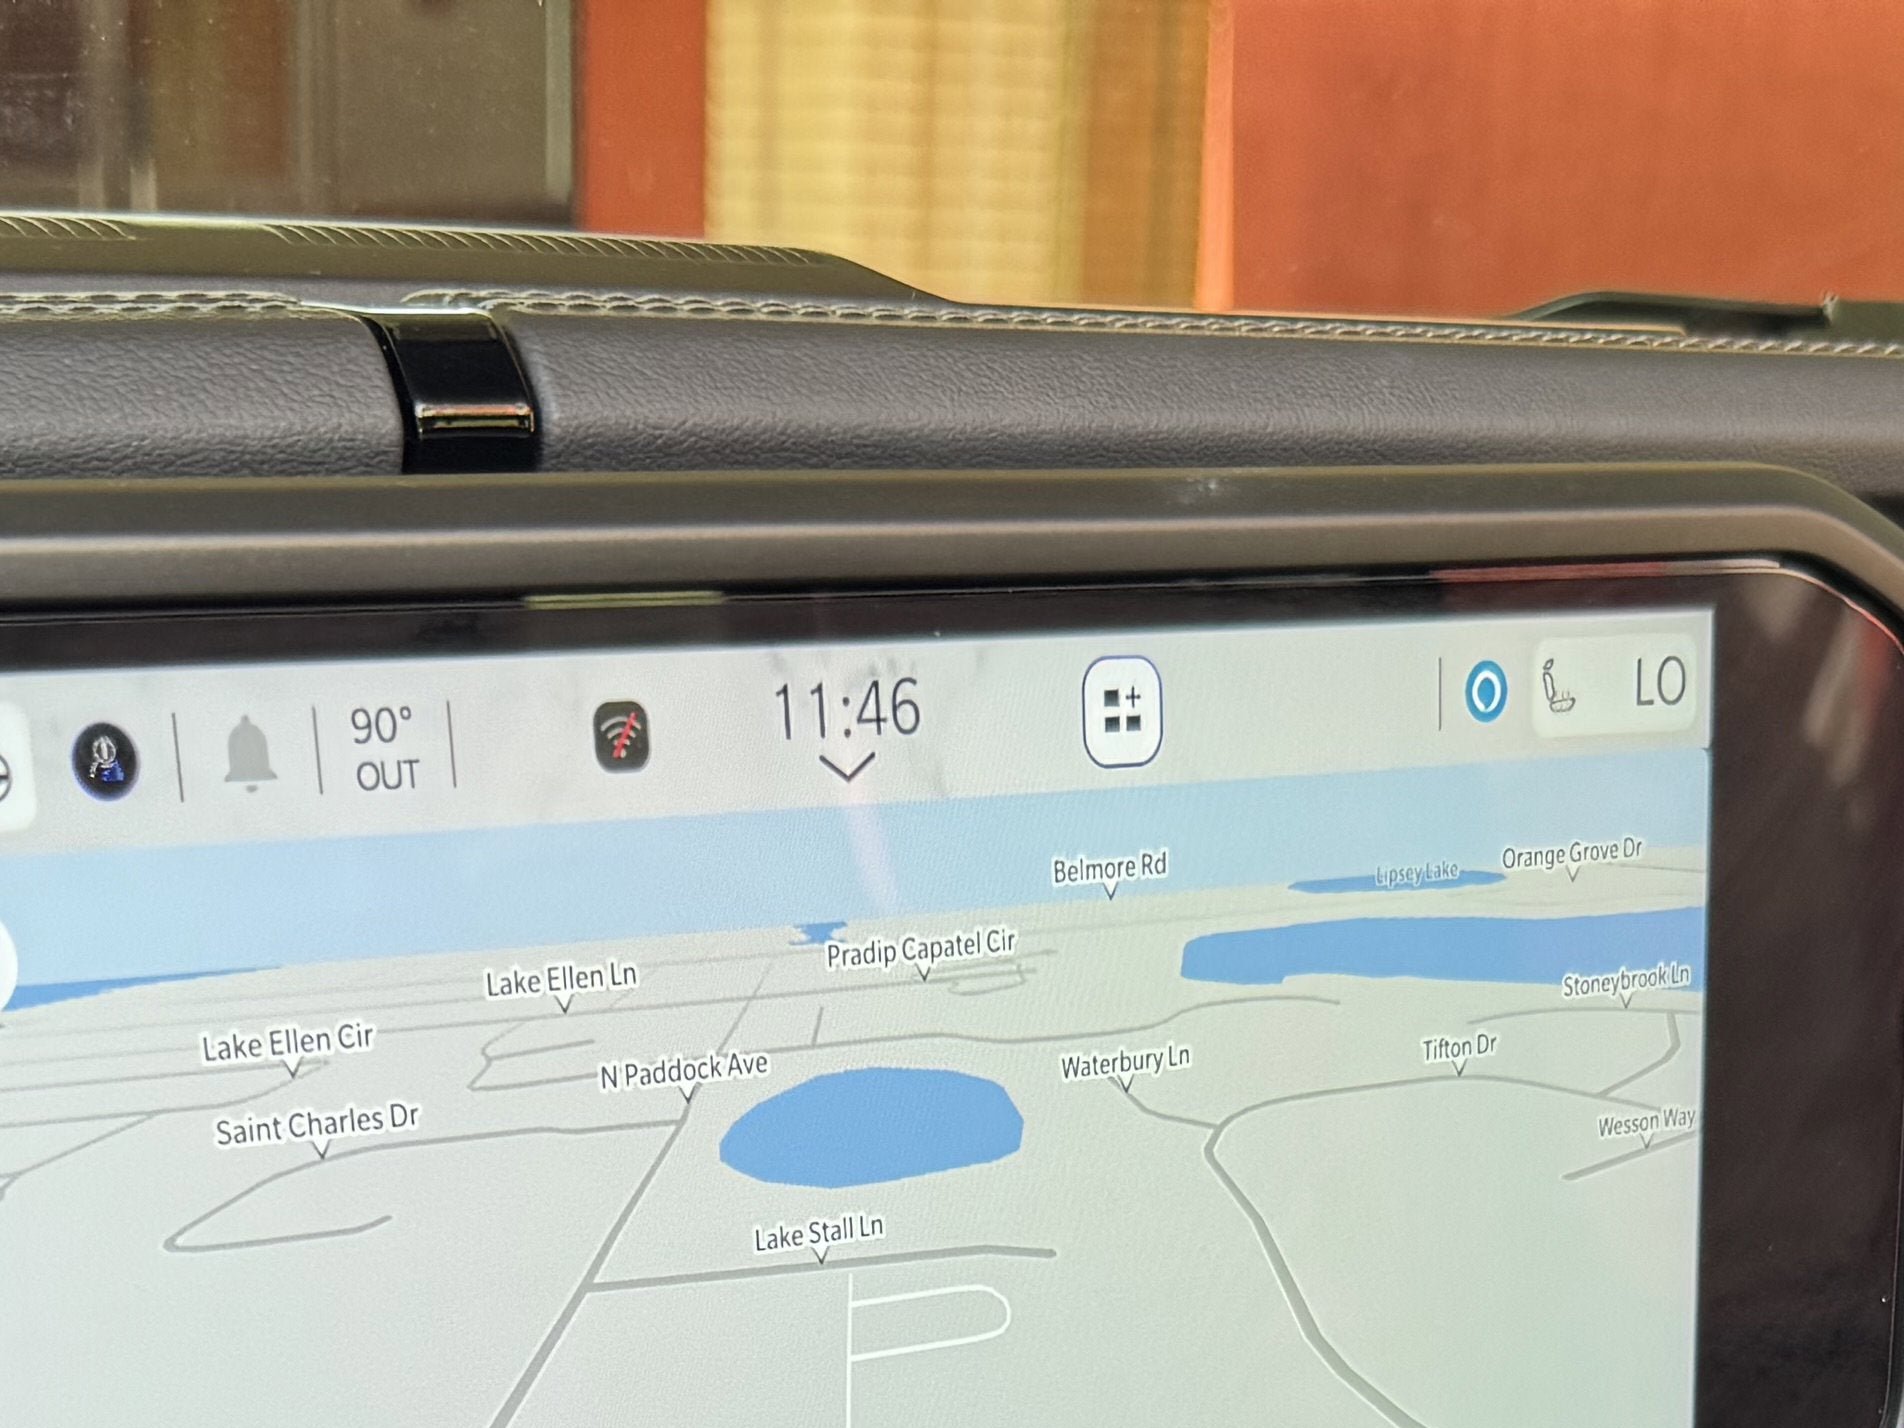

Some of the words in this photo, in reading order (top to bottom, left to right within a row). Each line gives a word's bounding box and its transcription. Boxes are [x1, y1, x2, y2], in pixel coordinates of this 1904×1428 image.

[1636, 655, 1687, 707] LO
[350, 705, 413, 744] 90°
[775, 676, 921, 740] 11:46
[355, 759, 421, 793] OUT
[1053, 856, 1137, 886] Belmore
[1141, 850, 1168, 878] Rd
[1376, 865, 1423, 887] Lipsey
[1426, 861, 1459, 881] Lake
[1502, 847, 1566, 873] Orange
[1569, 841, 1619, 863] Grove
[1623, 837, 1643, 860] Dr
[826, 940, 897, 970] Pradip
[901, 932, 984, 967] Capatel
[987, 929, 1016, 954] Cir
[485, 967, 542, 999] Lake
[547, 964, 604, 994] Ellen
[610, 961, 637, 989] Ln
[1563, 968, 1669, 999] Stoneybrook
[1671, 964, 1691, 985] Ln
[201, 1031, 263, 1064] Lake
[268, 1027, 332, 1057] Ellen
[338, 1023, 375, 1051] Cir
[1061, 1049, 1165, 1081] Waterbury
[1167, 1044, 1190, 1069] Ln
[1423, 1037, 1473, 1062] Tifton
[1476, 1033, 1497, 1055] Dr
[600, 1064, 618, 1091] N
[623, 1057, 721, 1090] Paddock
[726, 1051, 769, 1079] Ave
[215, 1117, 283, 1149] Saint
[287, 1107, 384, 1140] Charles
[388, 1103, 420, 1131] Dr
[1598, 1112, 1659, 1138] Wesson
[1663, 1108, 1696, 1131] Way
[753, 1221, 802, 1253] Lake
[807, 1217, 855, 1249] Stall
[859, 1212, 884, 1240] Ln
